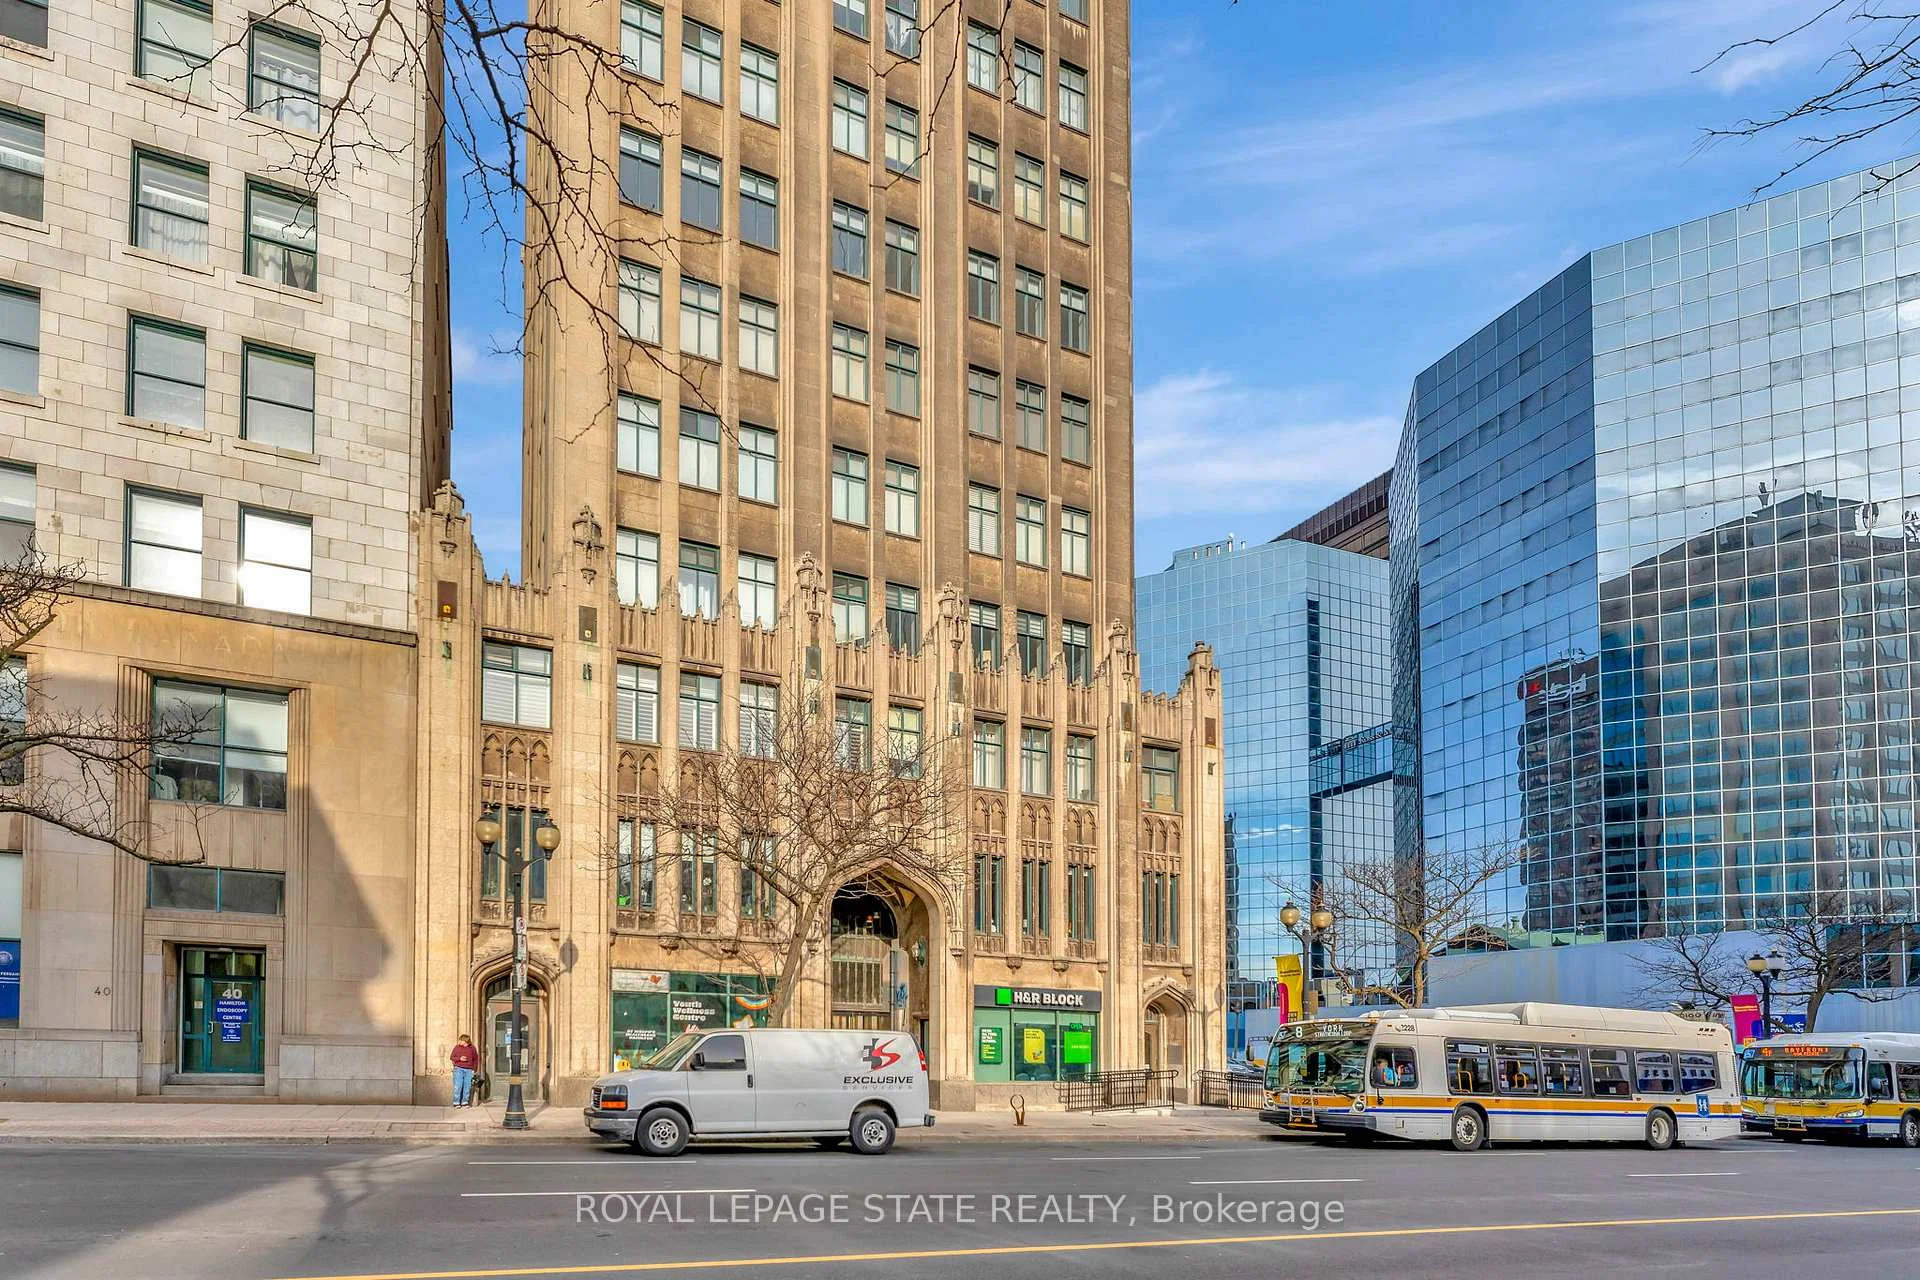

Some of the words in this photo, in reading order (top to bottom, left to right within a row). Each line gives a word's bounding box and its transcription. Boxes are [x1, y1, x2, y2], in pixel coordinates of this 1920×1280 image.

[94, 986, 111, 996] 40
[222, 988, 243, 999] 40
[1013, 991, 1041, 1004] H&R
[1042, 992, 1084, 1006] BLOCK
[672, 1000, 702, 1008] Youth
[672, 1007, 716, 1015] Wellness
[1295, 1026, 1303, 1038] 8
[1322, 1024, 1344, 1033] YORK
[843, 1076, 914, 1084] EXCLUSIVE
